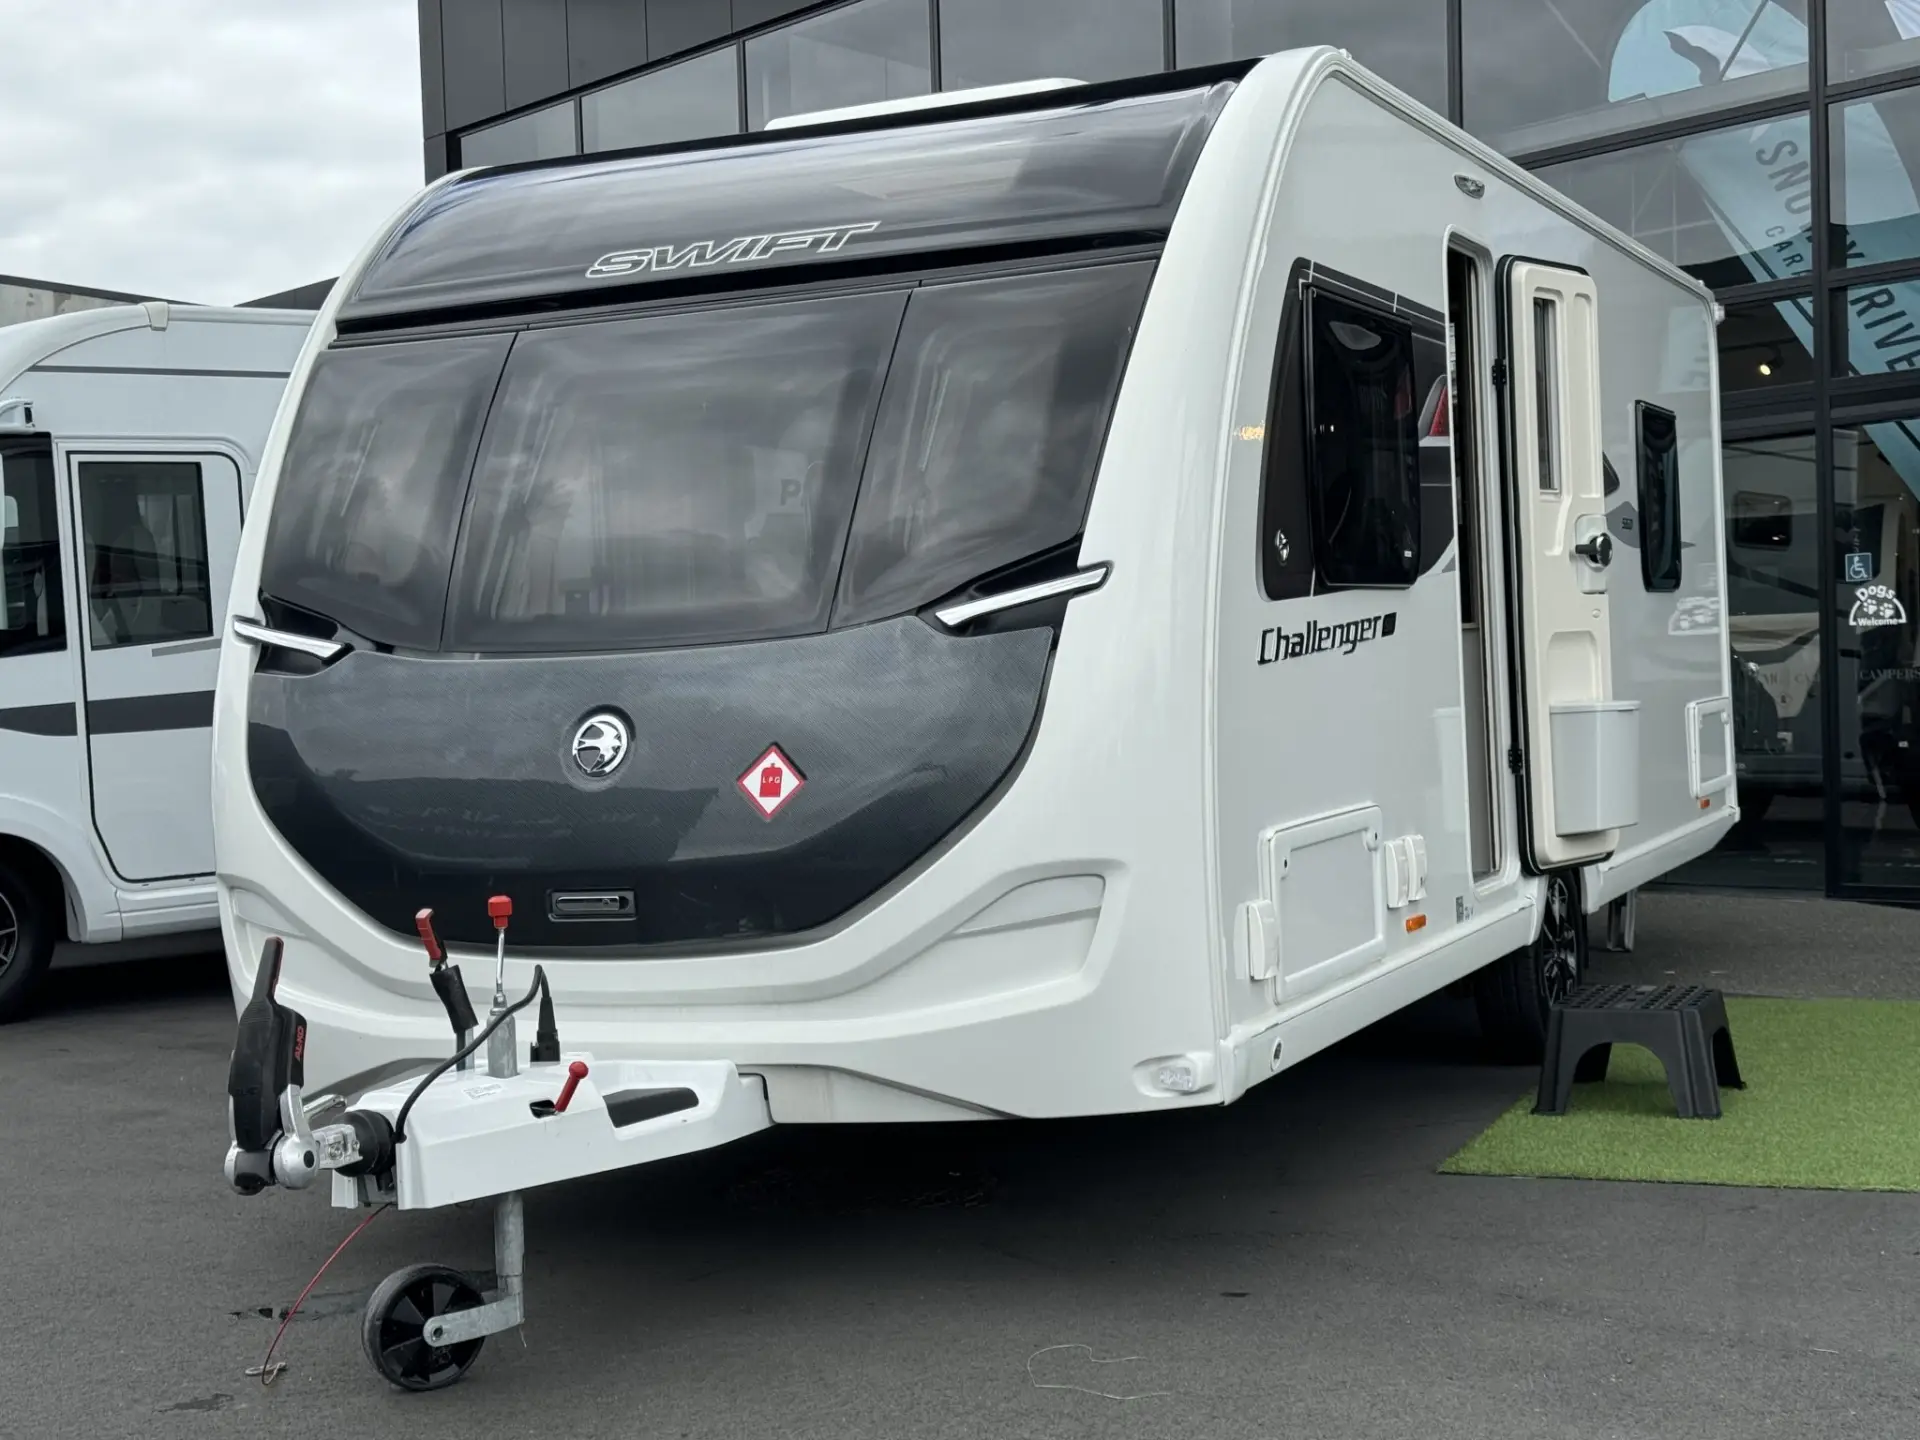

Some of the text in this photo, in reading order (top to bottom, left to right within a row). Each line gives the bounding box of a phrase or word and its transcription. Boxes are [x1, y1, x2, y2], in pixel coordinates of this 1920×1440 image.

[585, 220, 881, 278] SWIFT
[1855, 585, 1896, 602] Dogs
[1857, 617, 1899, 627] Welcome
[1257, 615, 1382, 666] Challenger
